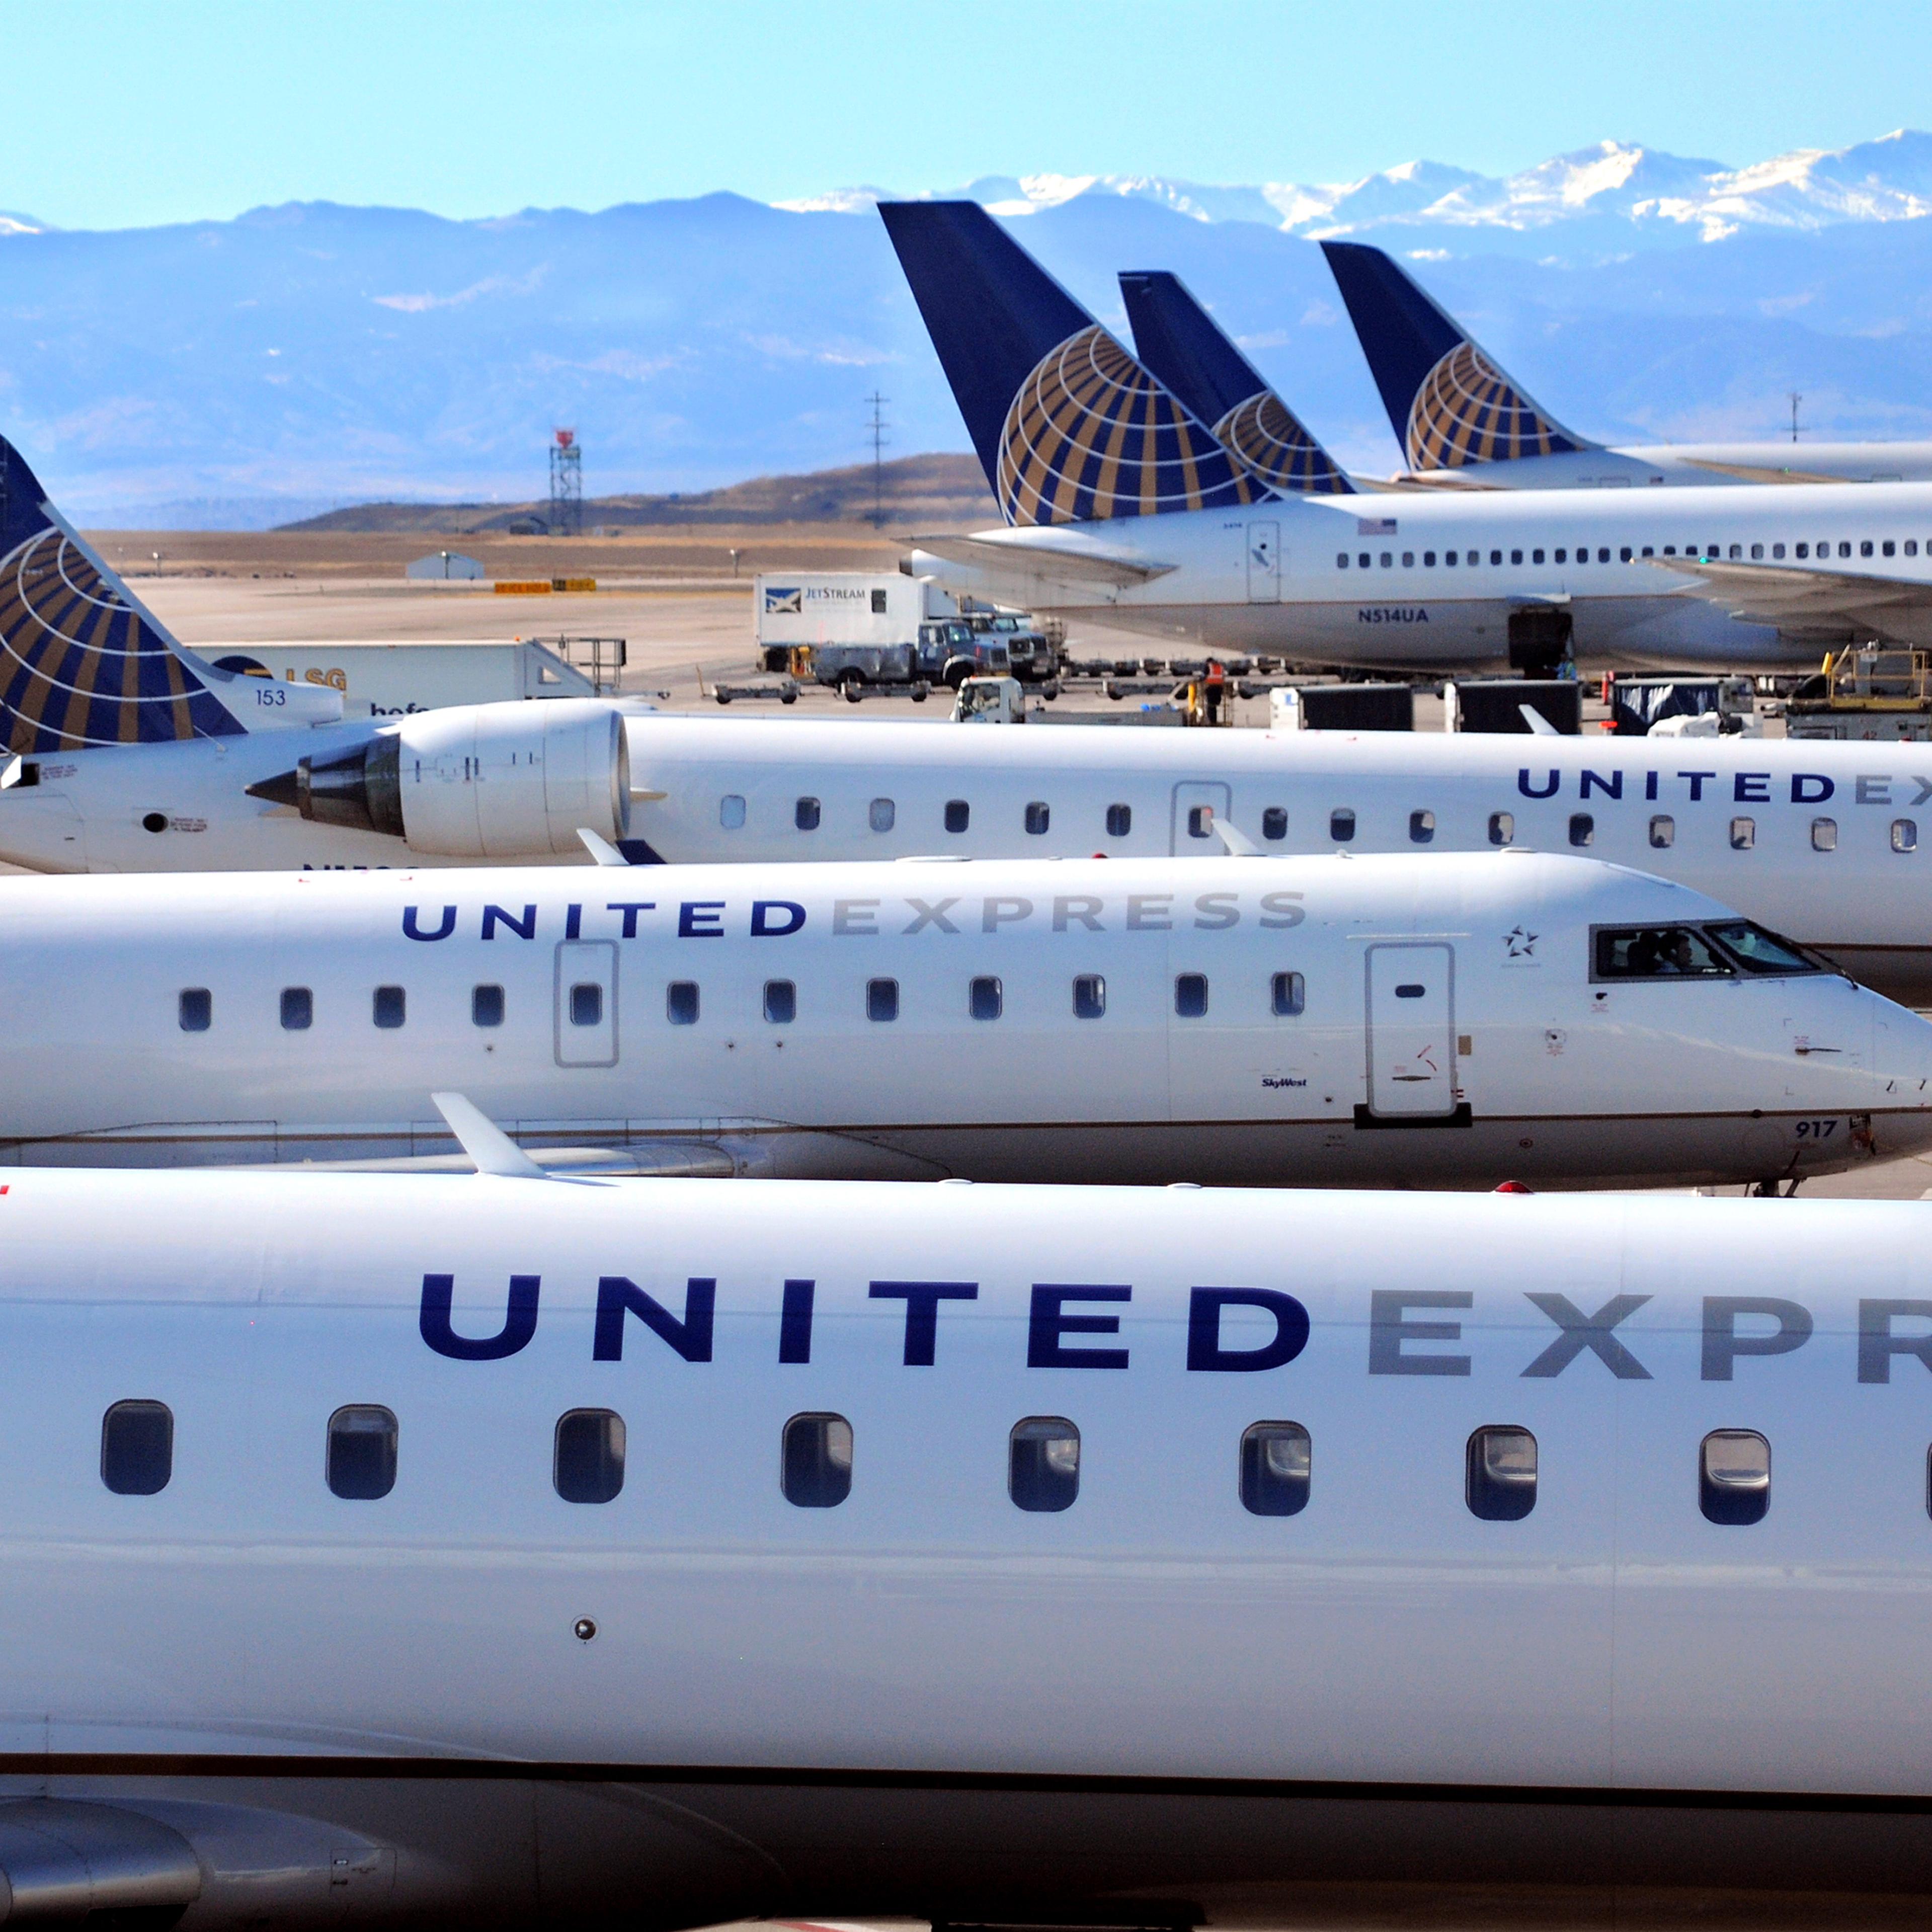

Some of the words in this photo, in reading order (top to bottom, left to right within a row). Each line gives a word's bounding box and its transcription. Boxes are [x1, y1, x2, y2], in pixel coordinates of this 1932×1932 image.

[1359, 608, 1429, 623] N514UA
[257, 689, 286, 705] 153
[1517, 769, 1835, 803] UNITED
[402, 901, 807, 941] UNITED
[832, 891, 1307, 936] EXPRESS
[1261, 1078, 1307, 1089] SkyWest
[1796, 1120, 1838, 1138] 917
[419, 1273, 1311, 1373] UNITED
[1368, 1289, 1932, 1384] EXPR
